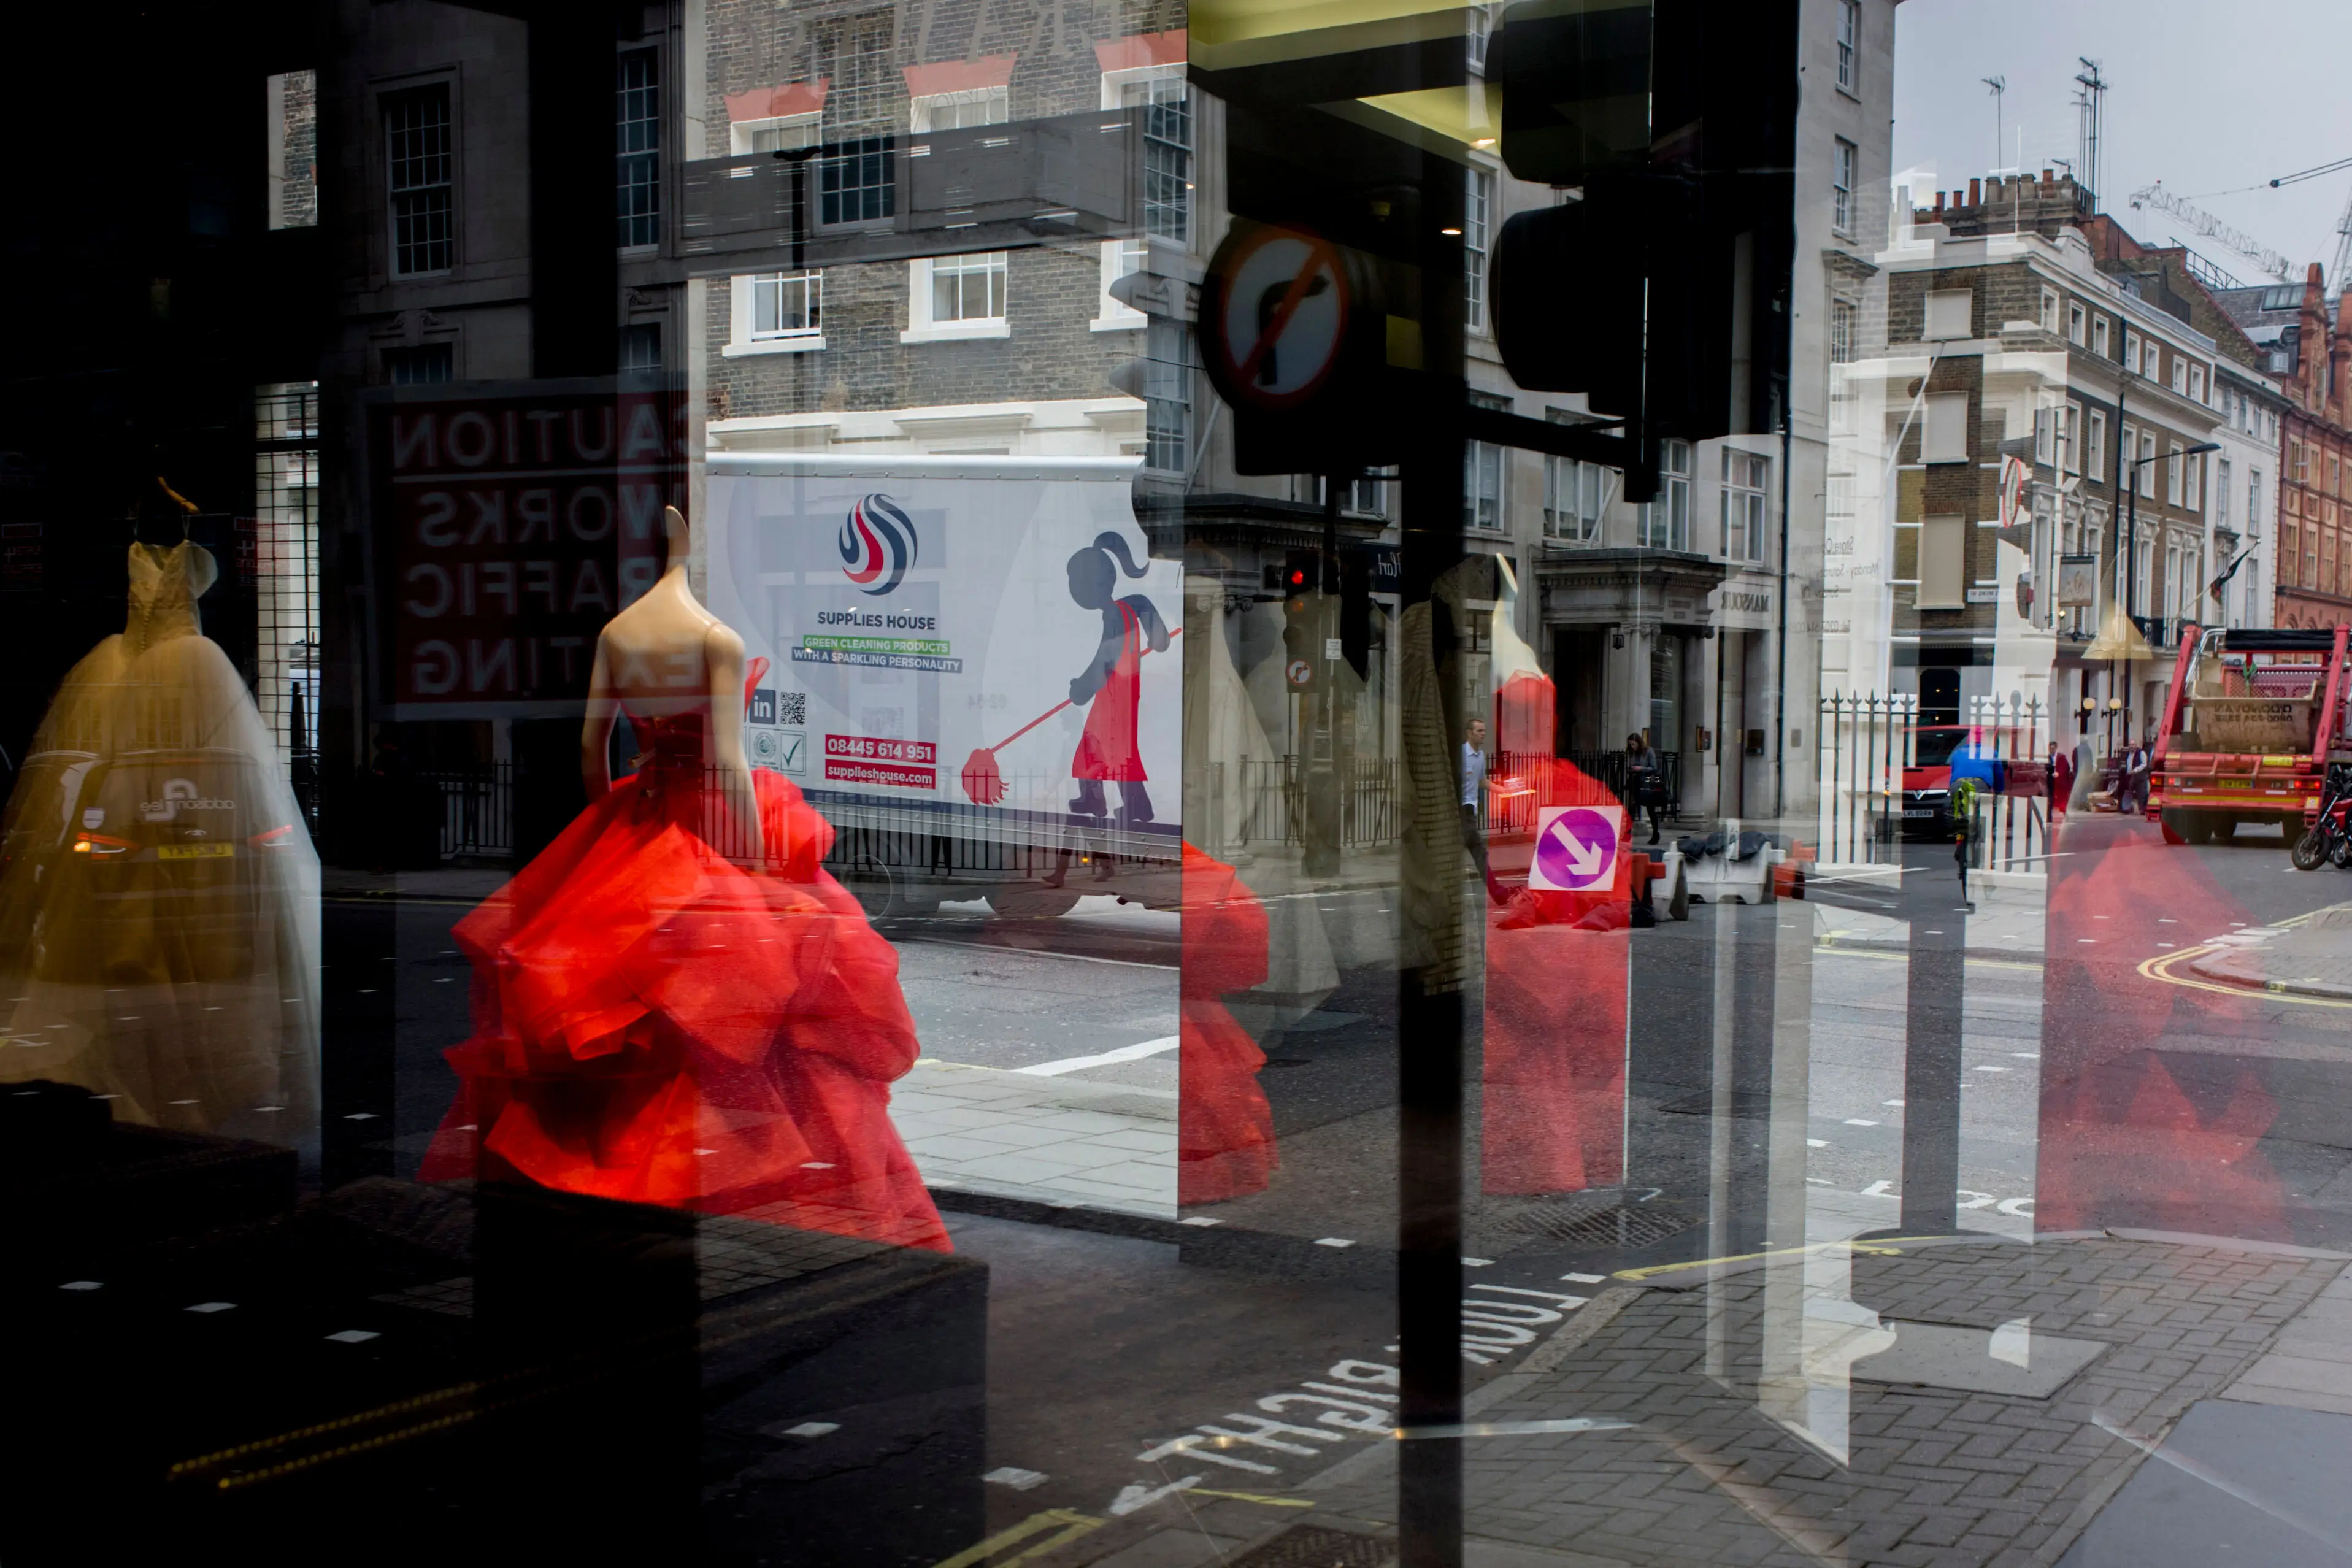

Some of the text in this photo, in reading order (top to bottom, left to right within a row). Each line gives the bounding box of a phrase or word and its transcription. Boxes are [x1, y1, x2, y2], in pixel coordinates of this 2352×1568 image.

[817, 611, 936, 630] SUPPLIES HOUSE
[805, 636, 948, 653] GREEN CLEANING PRODUCTS
[793, 648, 960, 671] WITH A SPARKLING PERSONALITY
[753, 695, 771, 718] in
[827, 737, 931, 761] 08445 614 951
[828, 765, 932, 785] supplieshouse.com
